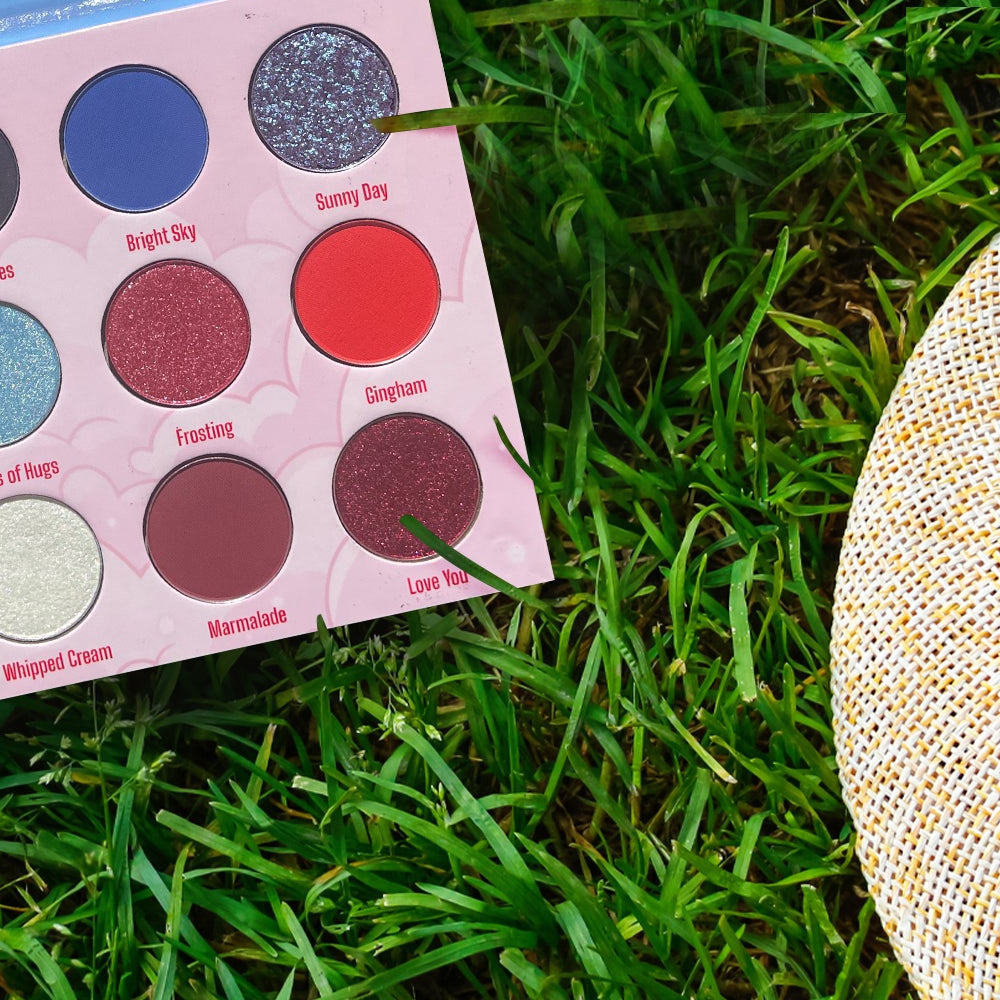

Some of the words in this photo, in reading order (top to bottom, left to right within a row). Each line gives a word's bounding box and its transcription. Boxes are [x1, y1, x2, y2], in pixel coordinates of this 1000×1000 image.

[315, 188, 360, 212] Sunny
[361, 182, 389, 203] Day
[126, 226, 170, 252] Bright
[169, 222, 198, 244] Sky
[365, 378, 428, 406] Gingham
[175, 420, 235, 448] Frosting
[5, 464, 23, 485] of
[22, 459, 61, 482] Hugs
[406, 576, 441, 596] Love
[441, 568, 470, 588] You
[206, 606, 288, 639] Marmalade
[1, 652, 66, 682] Whipped
[66, 644, 114, 669] Cream
